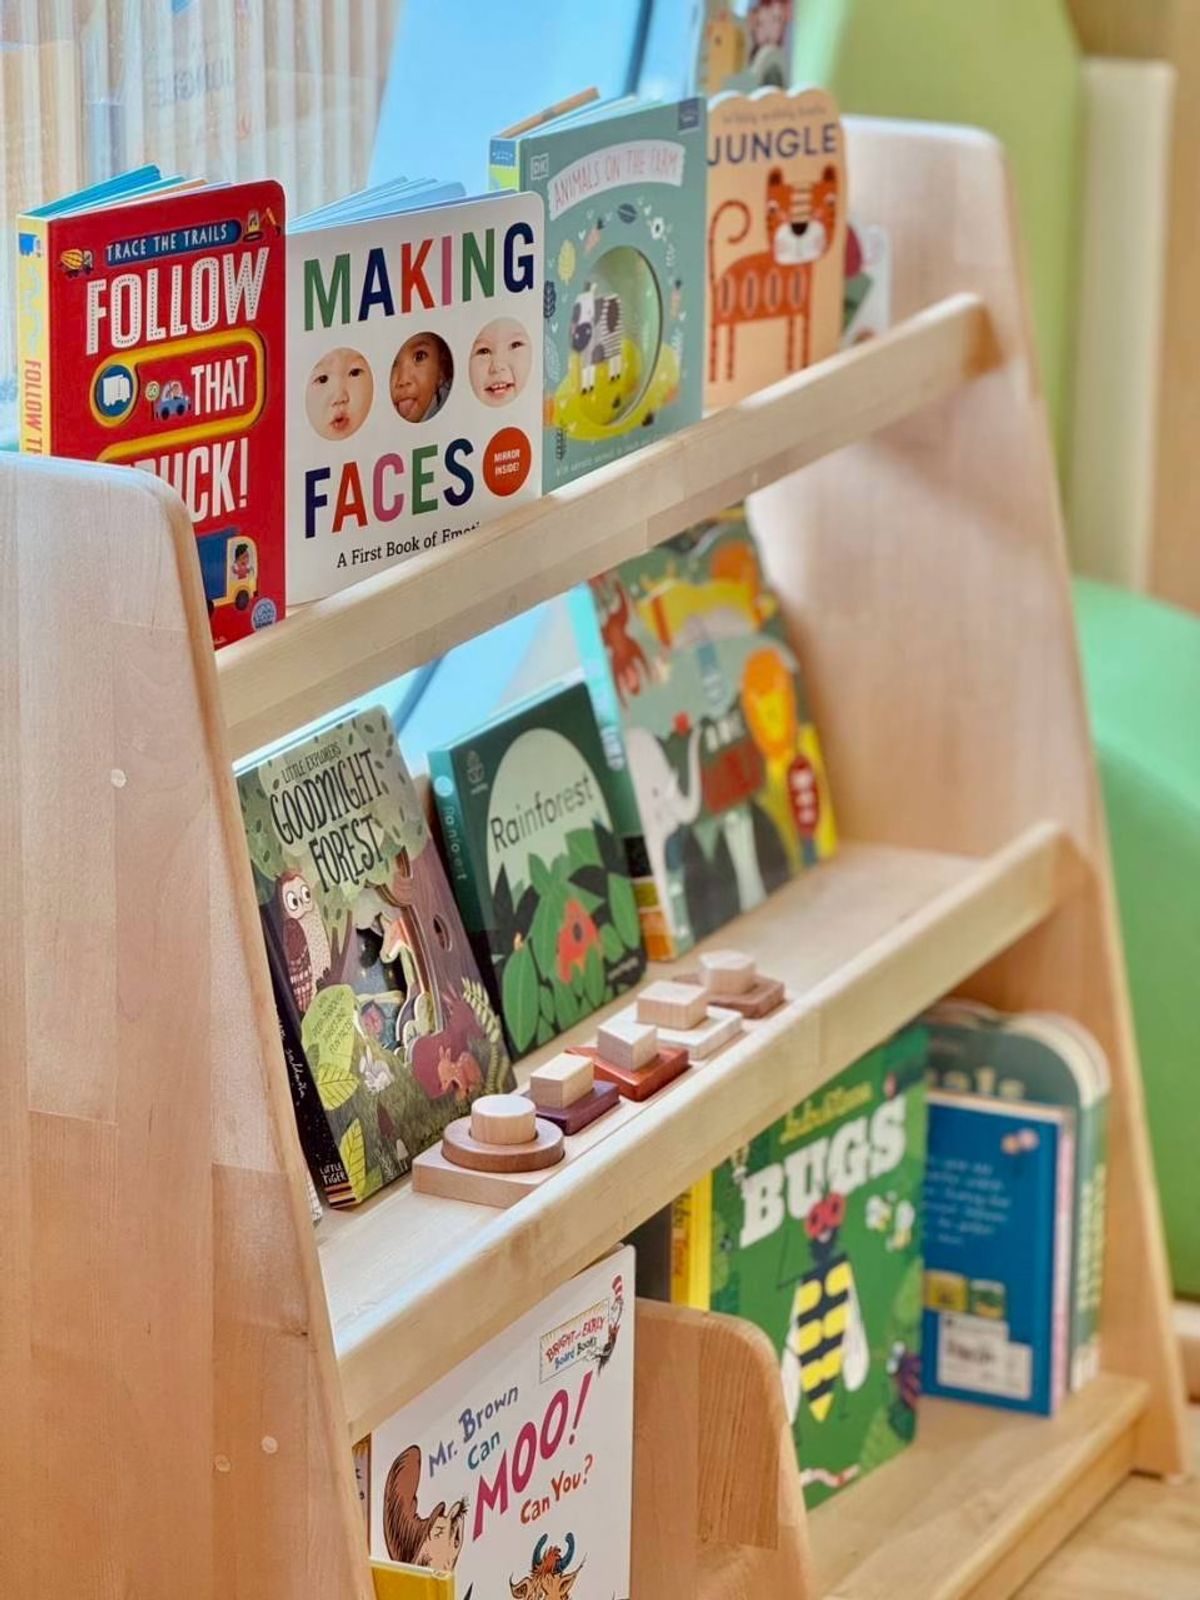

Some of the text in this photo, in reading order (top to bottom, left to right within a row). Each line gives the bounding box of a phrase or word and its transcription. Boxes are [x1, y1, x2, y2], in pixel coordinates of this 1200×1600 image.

[707, 124, 837, 166] JUNGLE
[554, 160, 599, 210] ANIMALS
[106, 226, 228, 262] TRACE THE TRAILS
[86, 247, 270, 356] FOLLOW
[304, 222, 534, 331] MAKING
[25, 360, 42, 428] FOLLOW
[191, 355, 248, 416] THAT
[494, 449, 520, 463] MIRROR
[305, 438, 475, 539] FACES
[336, 552, 347, 568] A
[351, 546, 382, 566] First
[386, 536, 420, 557] Book
[423, 531, 438, 549] of
[270, 748, 383, 845] GOODNIGHT
[281, 760, 306, 784] LITTLE
[490, 775, 594, 852] Rainforest
[309, 813, 384, 893] FOREST
[320, 1162, 343, 1175] LITTLE
[322, 1171, 347, 1185] TIGER
[740, 1095, 907, 1249] BUGS
[545, 1330, 576, 1362] BRIGHT
[428, 1386, 519, 1478] Mr. Brown
[468, 1432, 501, 1470] Can
[472, 1370, 593, 1541] MOO!
[520, 1453, 593, 1524] Can You?
